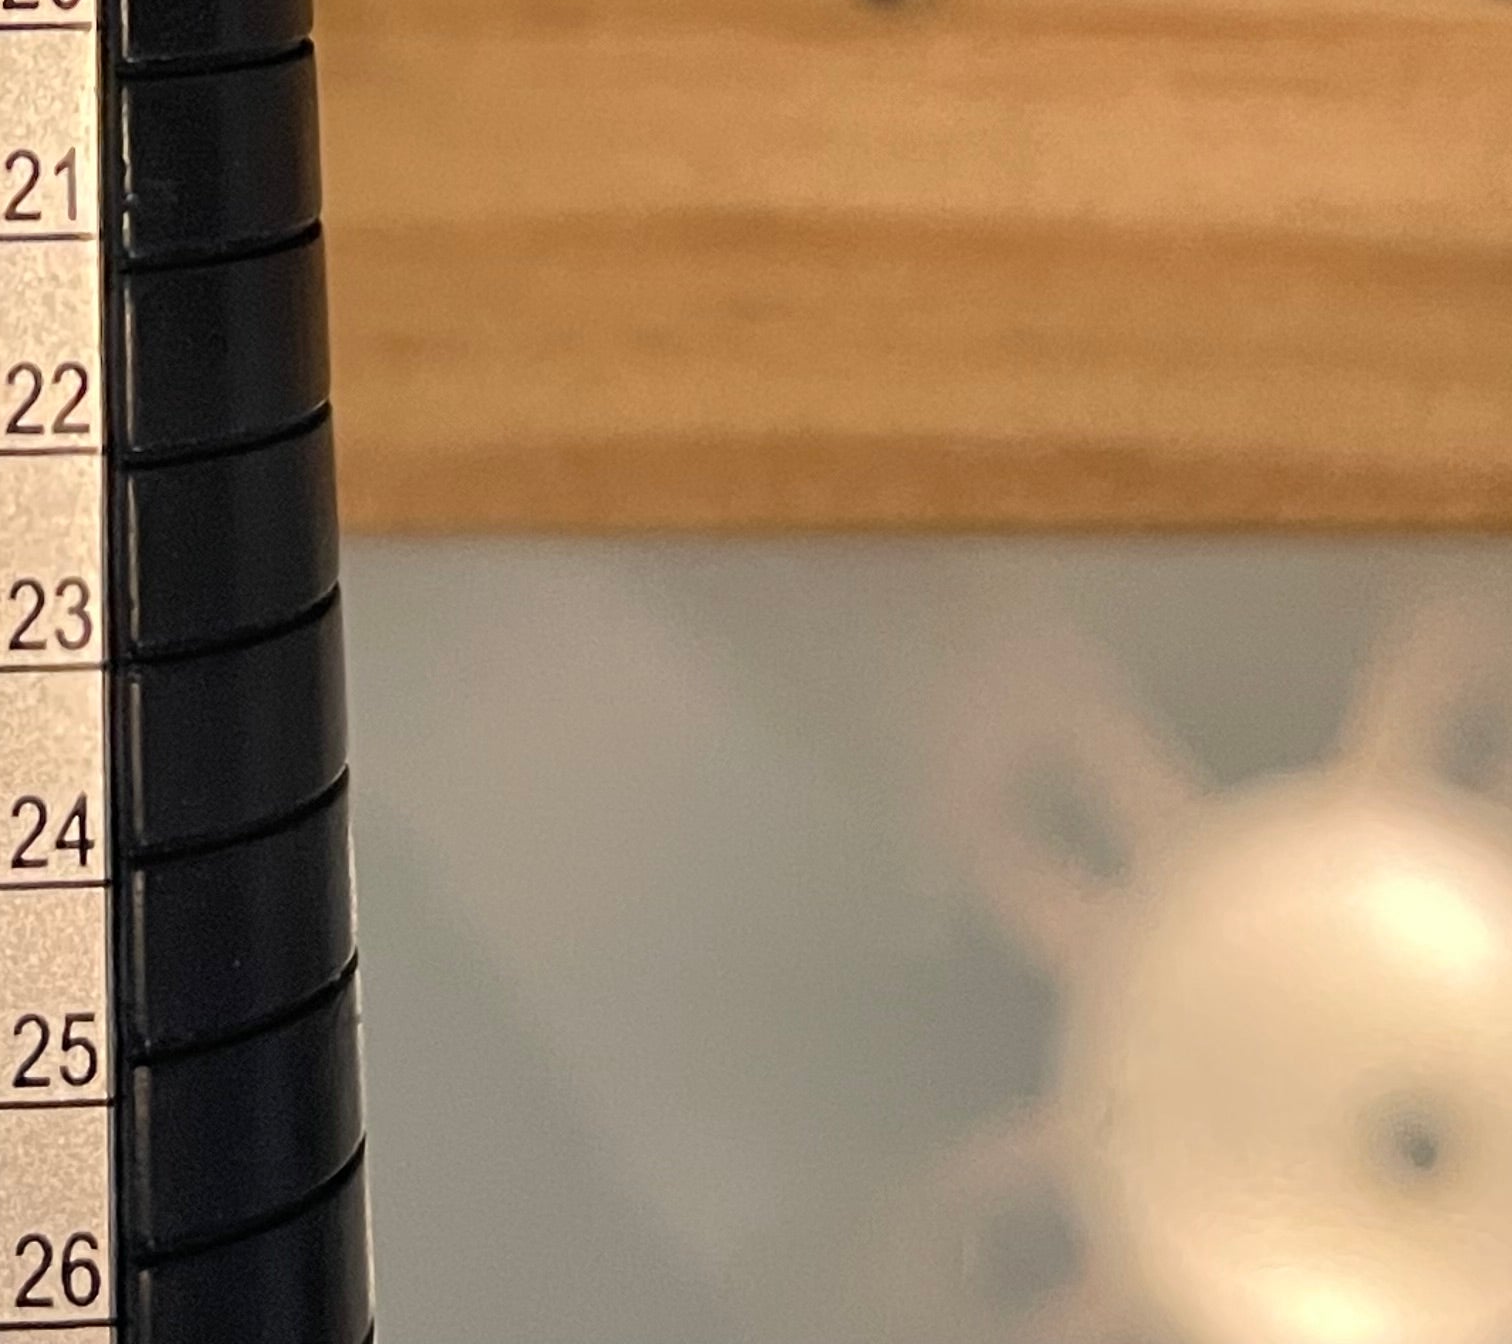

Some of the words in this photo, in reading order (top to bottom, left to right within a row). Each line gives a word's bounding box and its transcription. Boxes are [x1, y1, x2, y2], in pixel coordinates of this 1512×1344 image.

[3, 146, 77, 222] 21
[5, 362, 90, 436] 22
[7, 577, 92, 652] 23
[10, 793, 94, 870] 24
[11, 1012, 97, 1089] 25
[14, 1232, 100, 1309] 26
